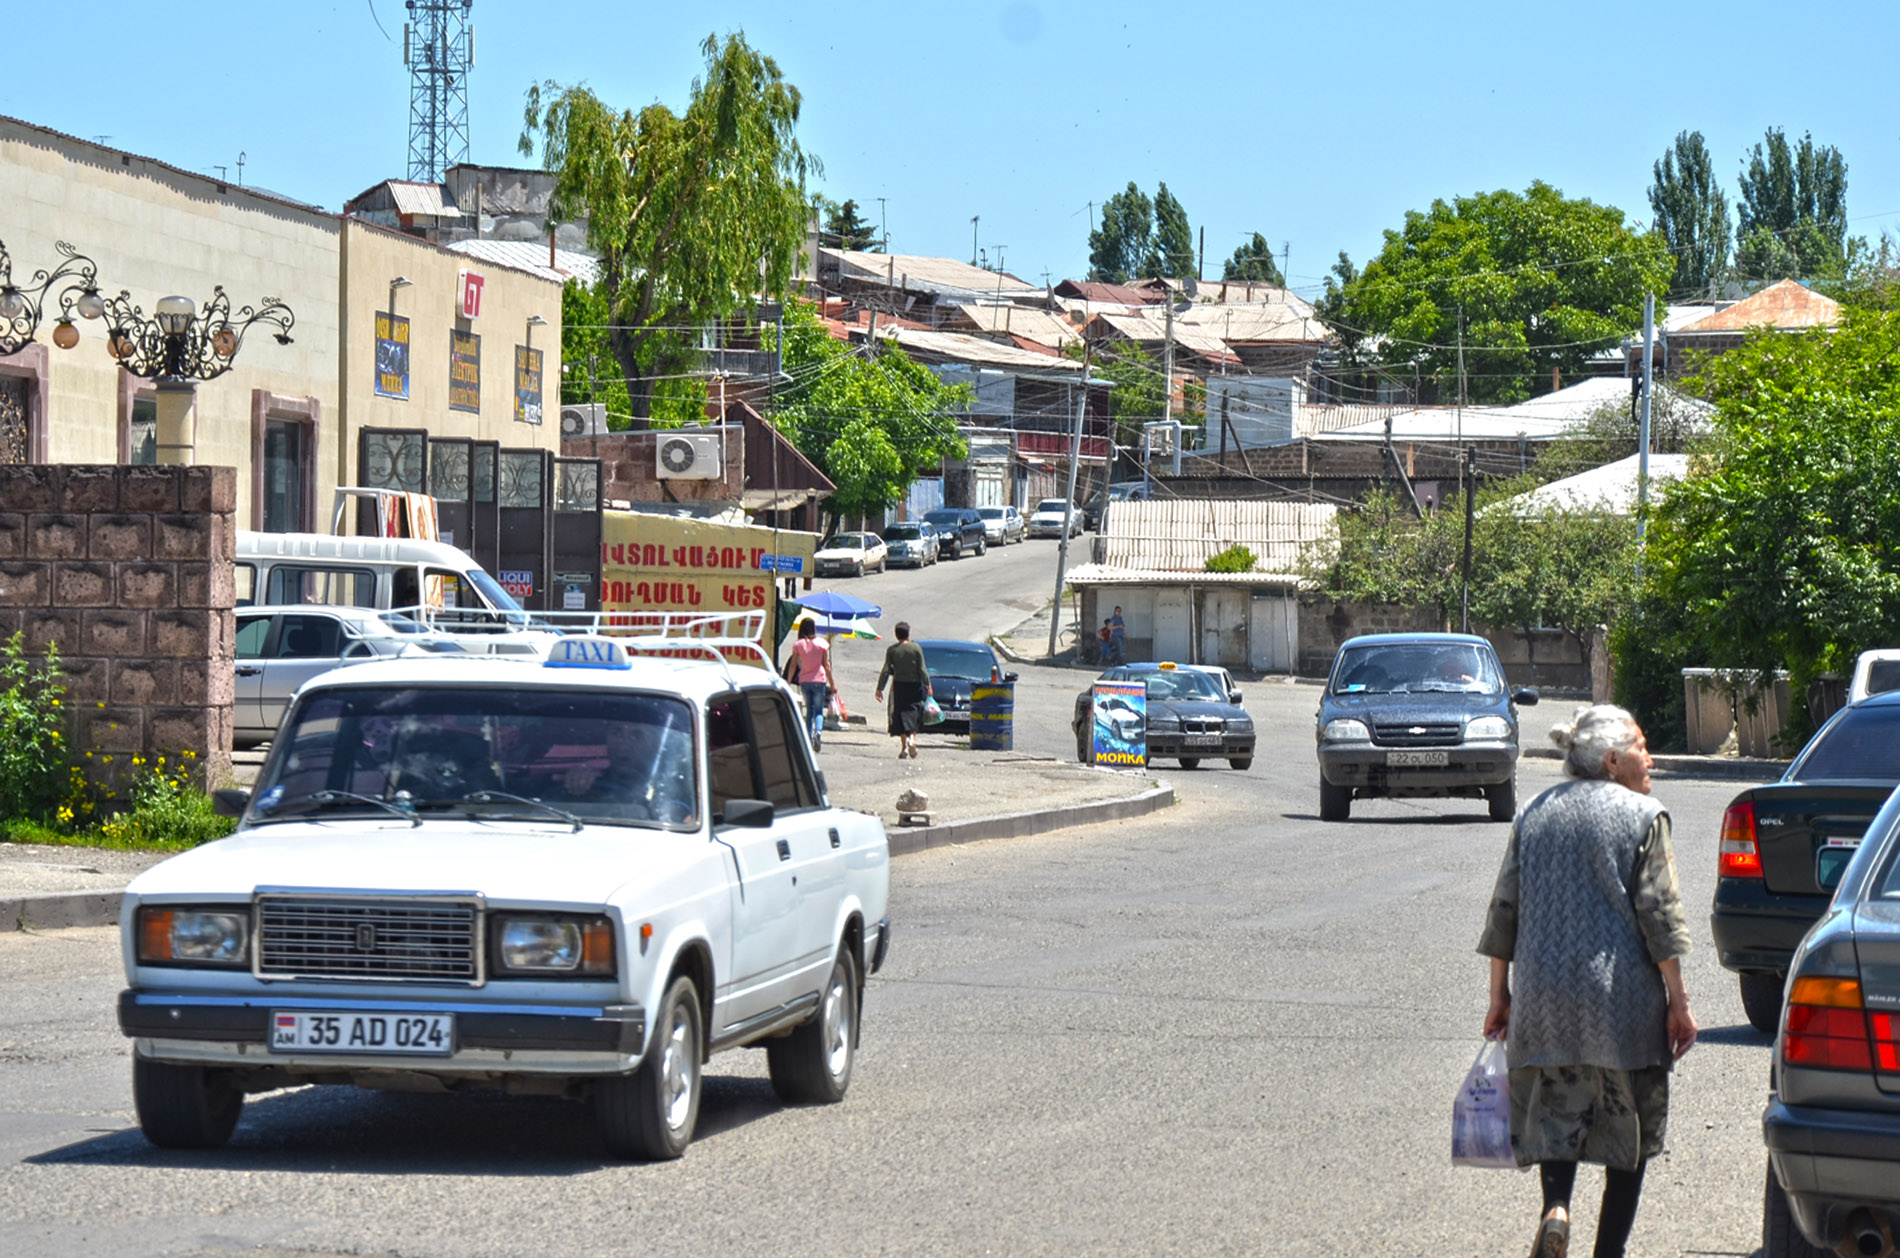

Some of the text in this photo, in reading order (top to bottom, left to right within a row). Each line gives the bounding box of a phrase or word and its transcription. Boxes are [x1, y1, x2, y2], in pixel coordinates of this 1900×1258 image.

[498, 571, 531, 583] LIQUI
[560, 640, 614, 662] TAXI
[1095, 752, 1145, 765] МОЙКА
[1396, 753, 1408, 763] 22
[1425, 753, 1444, 763] 050
[275, 1016, 443, 1048] AM 35 AD 024
